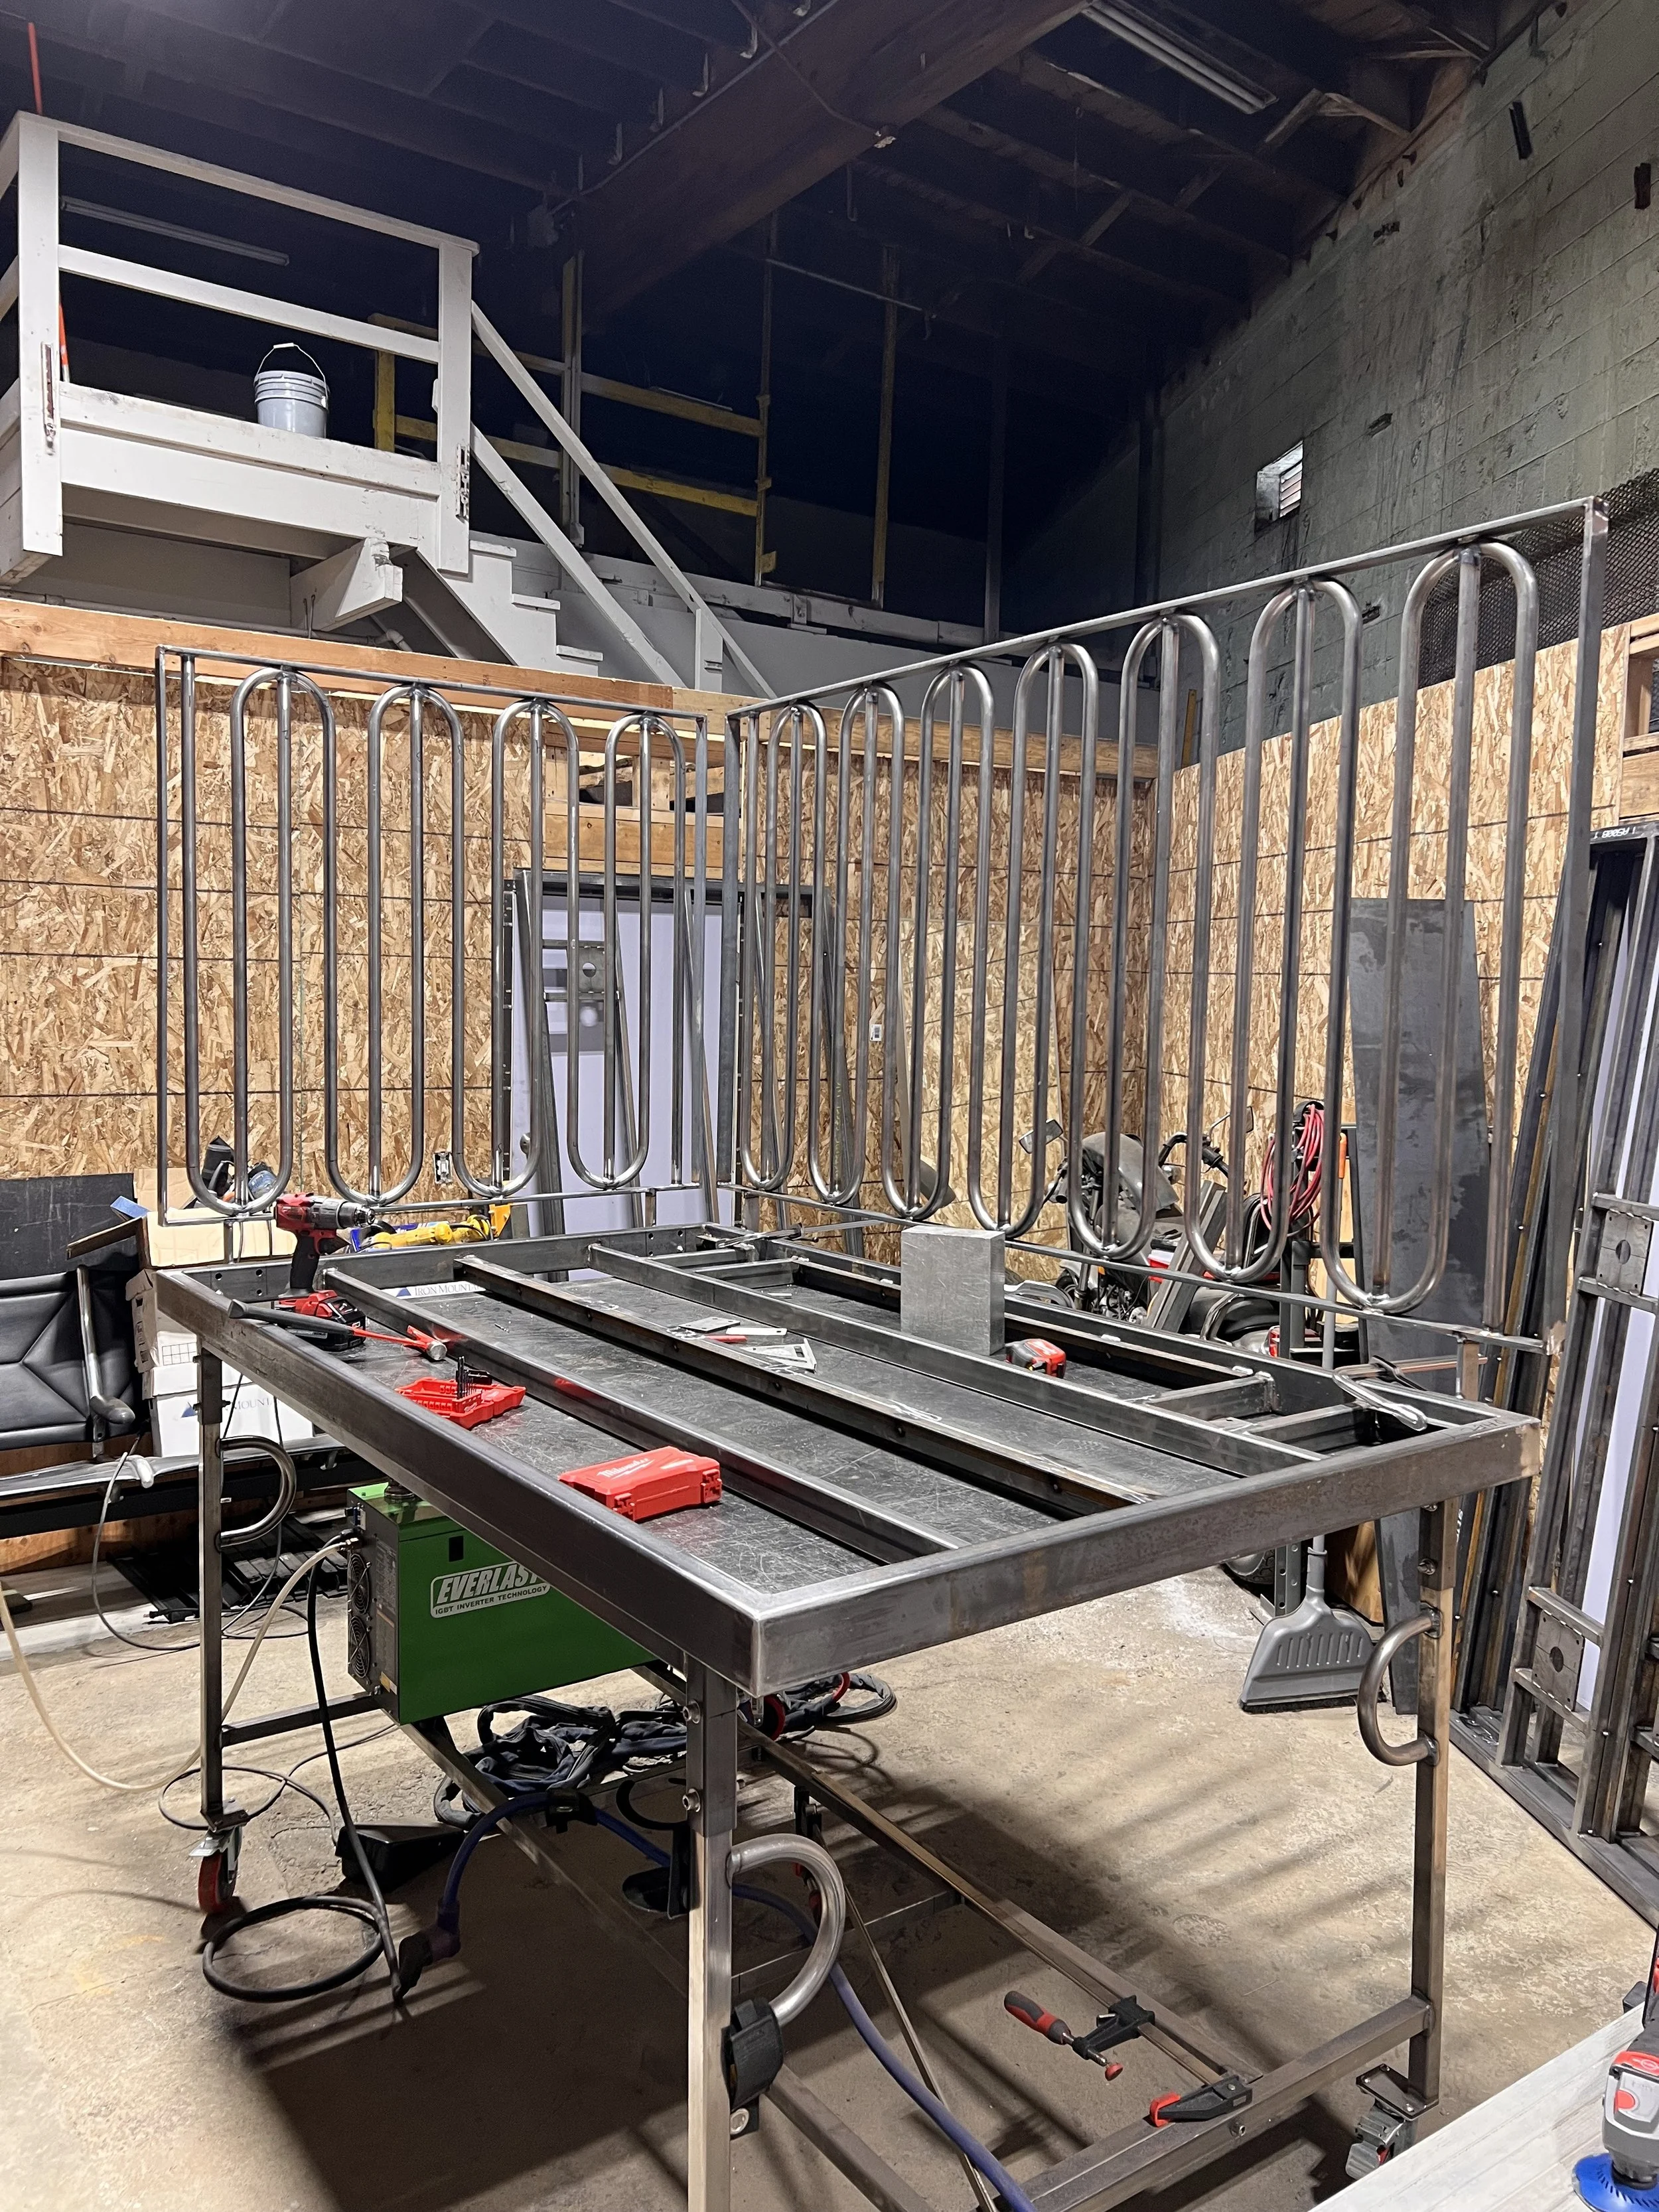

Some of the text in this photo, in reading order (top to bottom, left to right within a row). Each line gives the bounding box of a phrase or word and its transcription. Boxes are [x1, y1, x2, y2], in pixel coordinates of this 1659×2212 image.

[415, 1284, 478, 1296] IRON MOUNTA
[435, 1585, 547, 1615] IGBT INVERTER TECHNOLOGY
